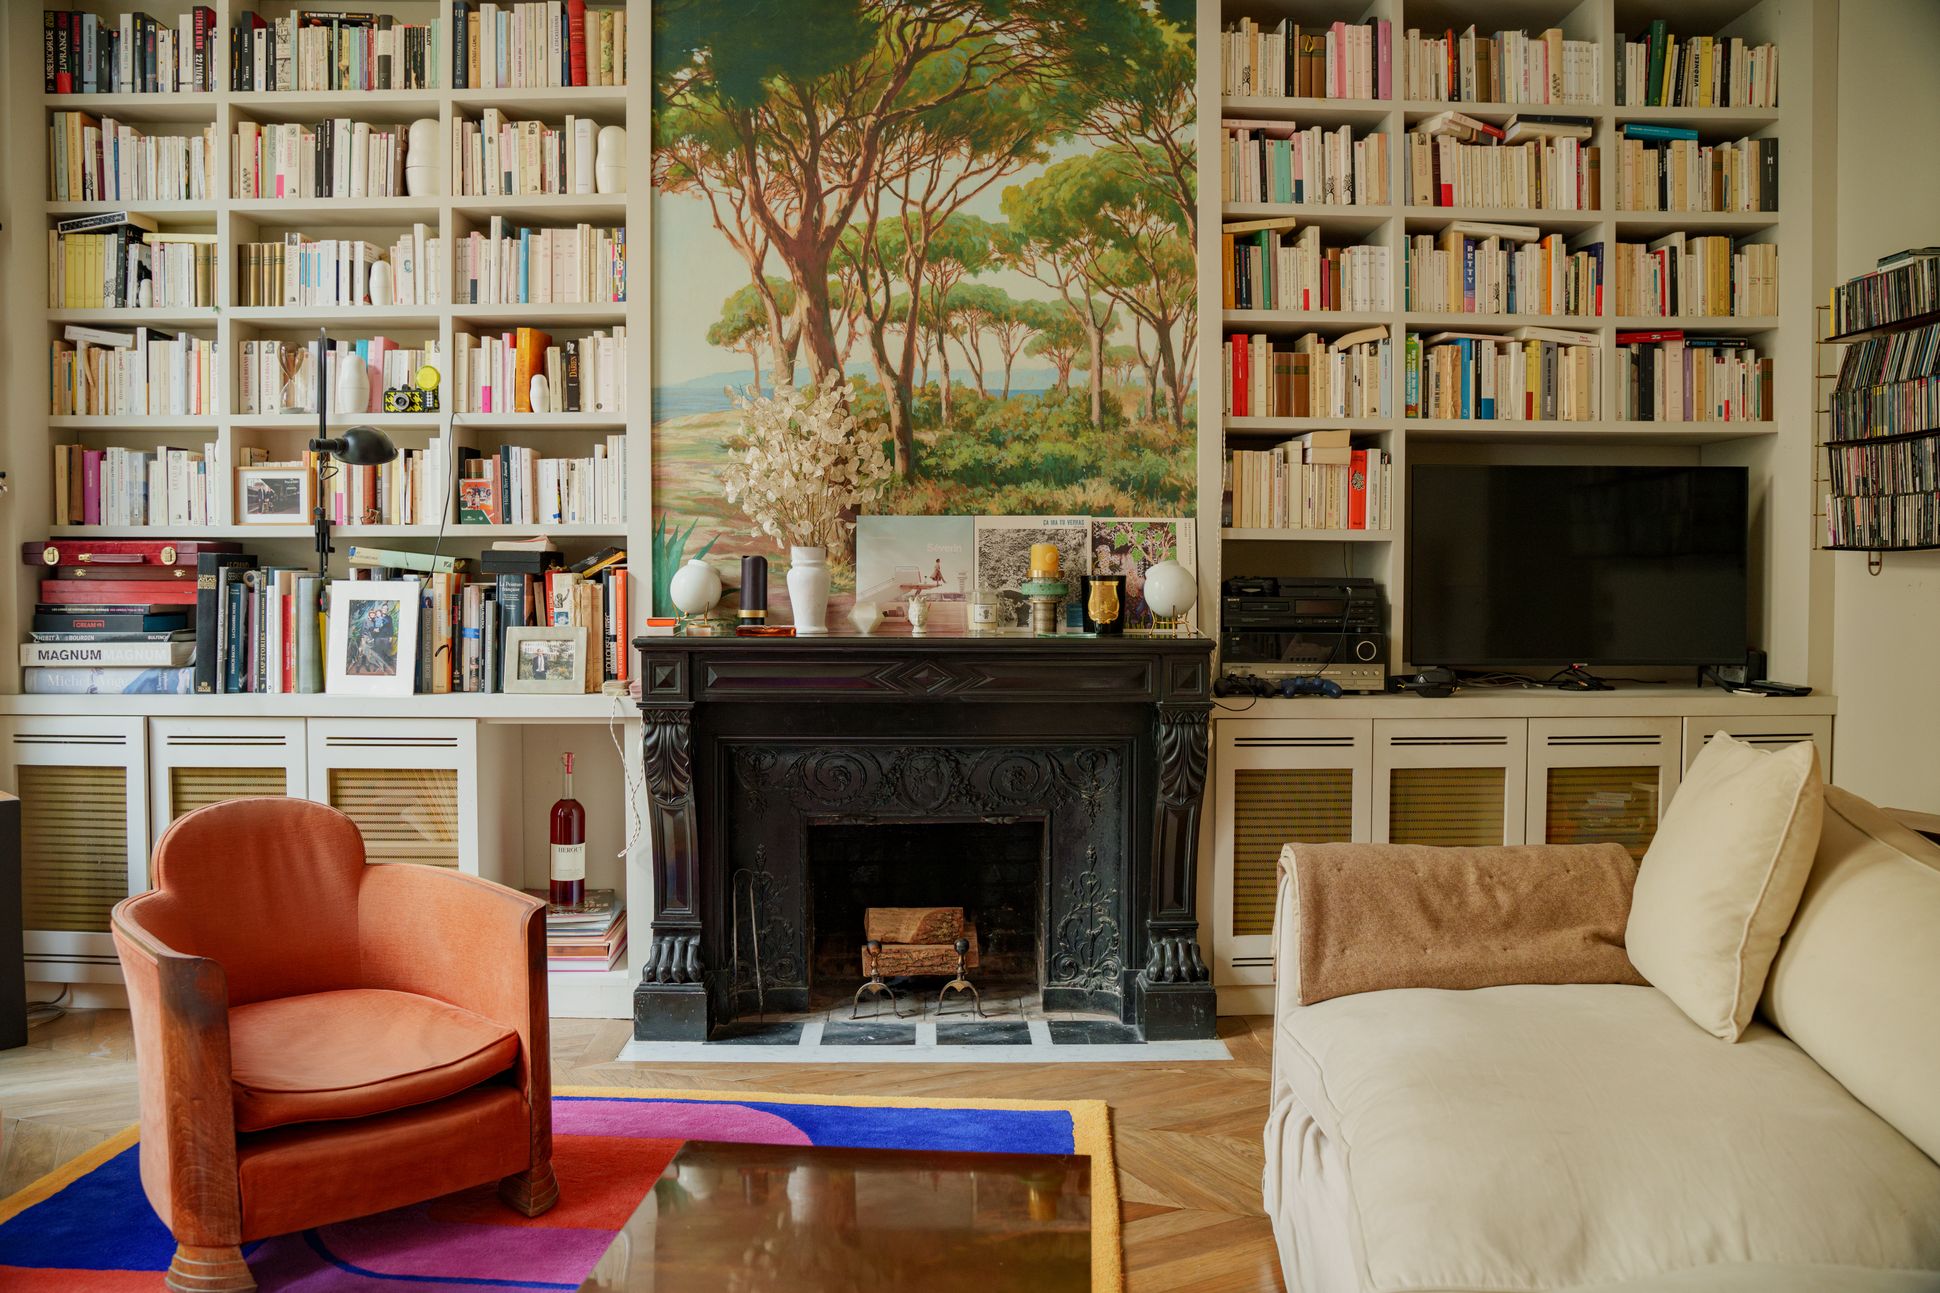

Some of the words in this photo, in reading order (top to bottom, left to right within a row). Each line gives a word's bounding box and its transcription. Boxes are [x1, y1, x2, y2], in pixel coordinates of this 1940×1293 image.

[58, 30, 67, 74] ELIVRANCE
[927, 543, 962, 552] Séverin
[38, 650, 101, 661] MAGNUM
[106, 649, 167, 660] MAGNUM
